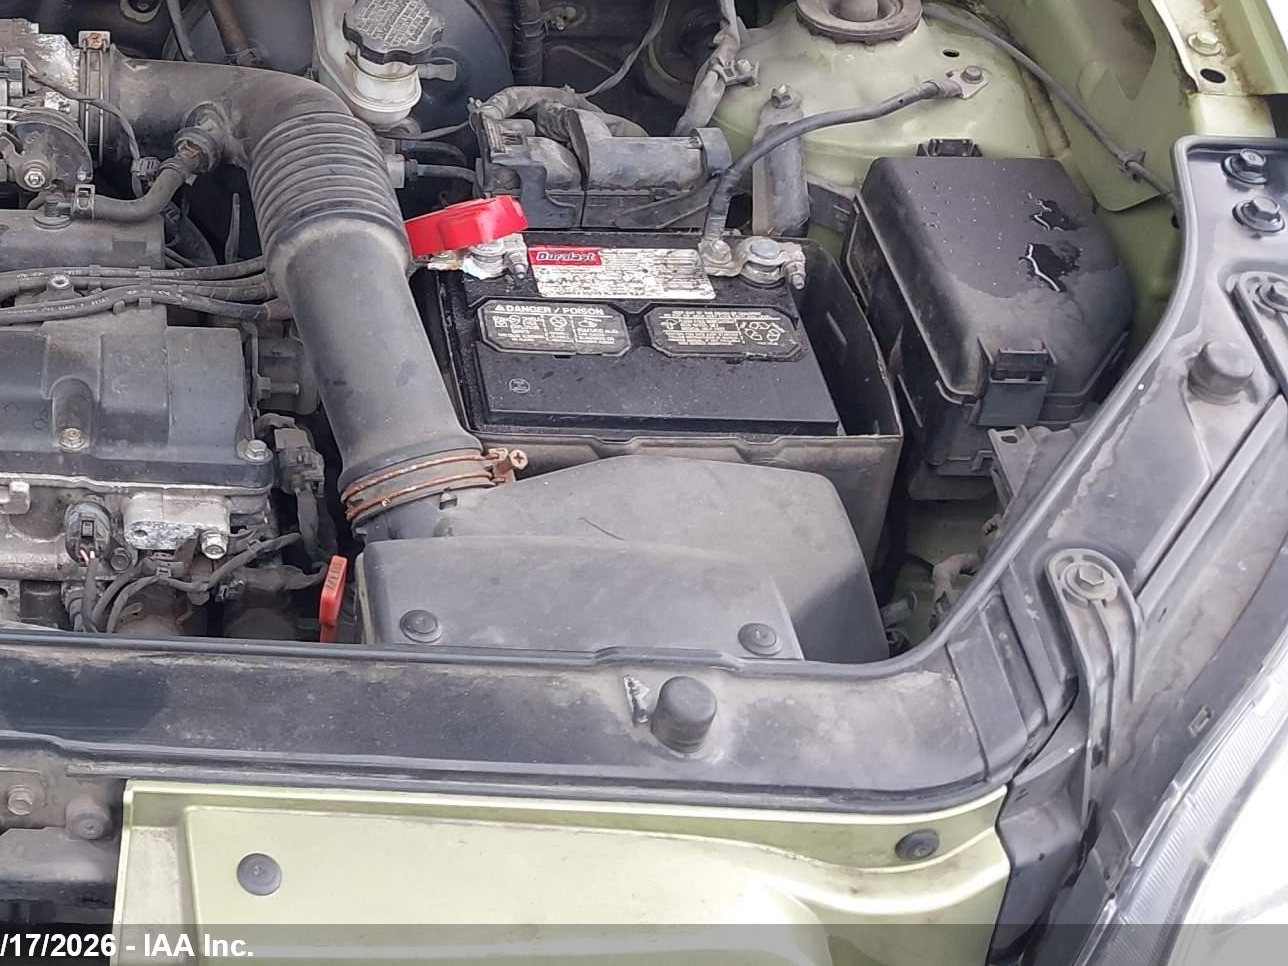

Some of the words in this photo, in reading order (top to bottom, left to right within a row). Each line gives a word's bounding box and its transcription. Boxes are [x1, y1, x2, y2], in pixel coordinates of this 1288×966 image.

[536, 251, 596, 263] Duralast
[505, 304, 552, 315] DANGER
[562, 307, 605, 316] POISON
